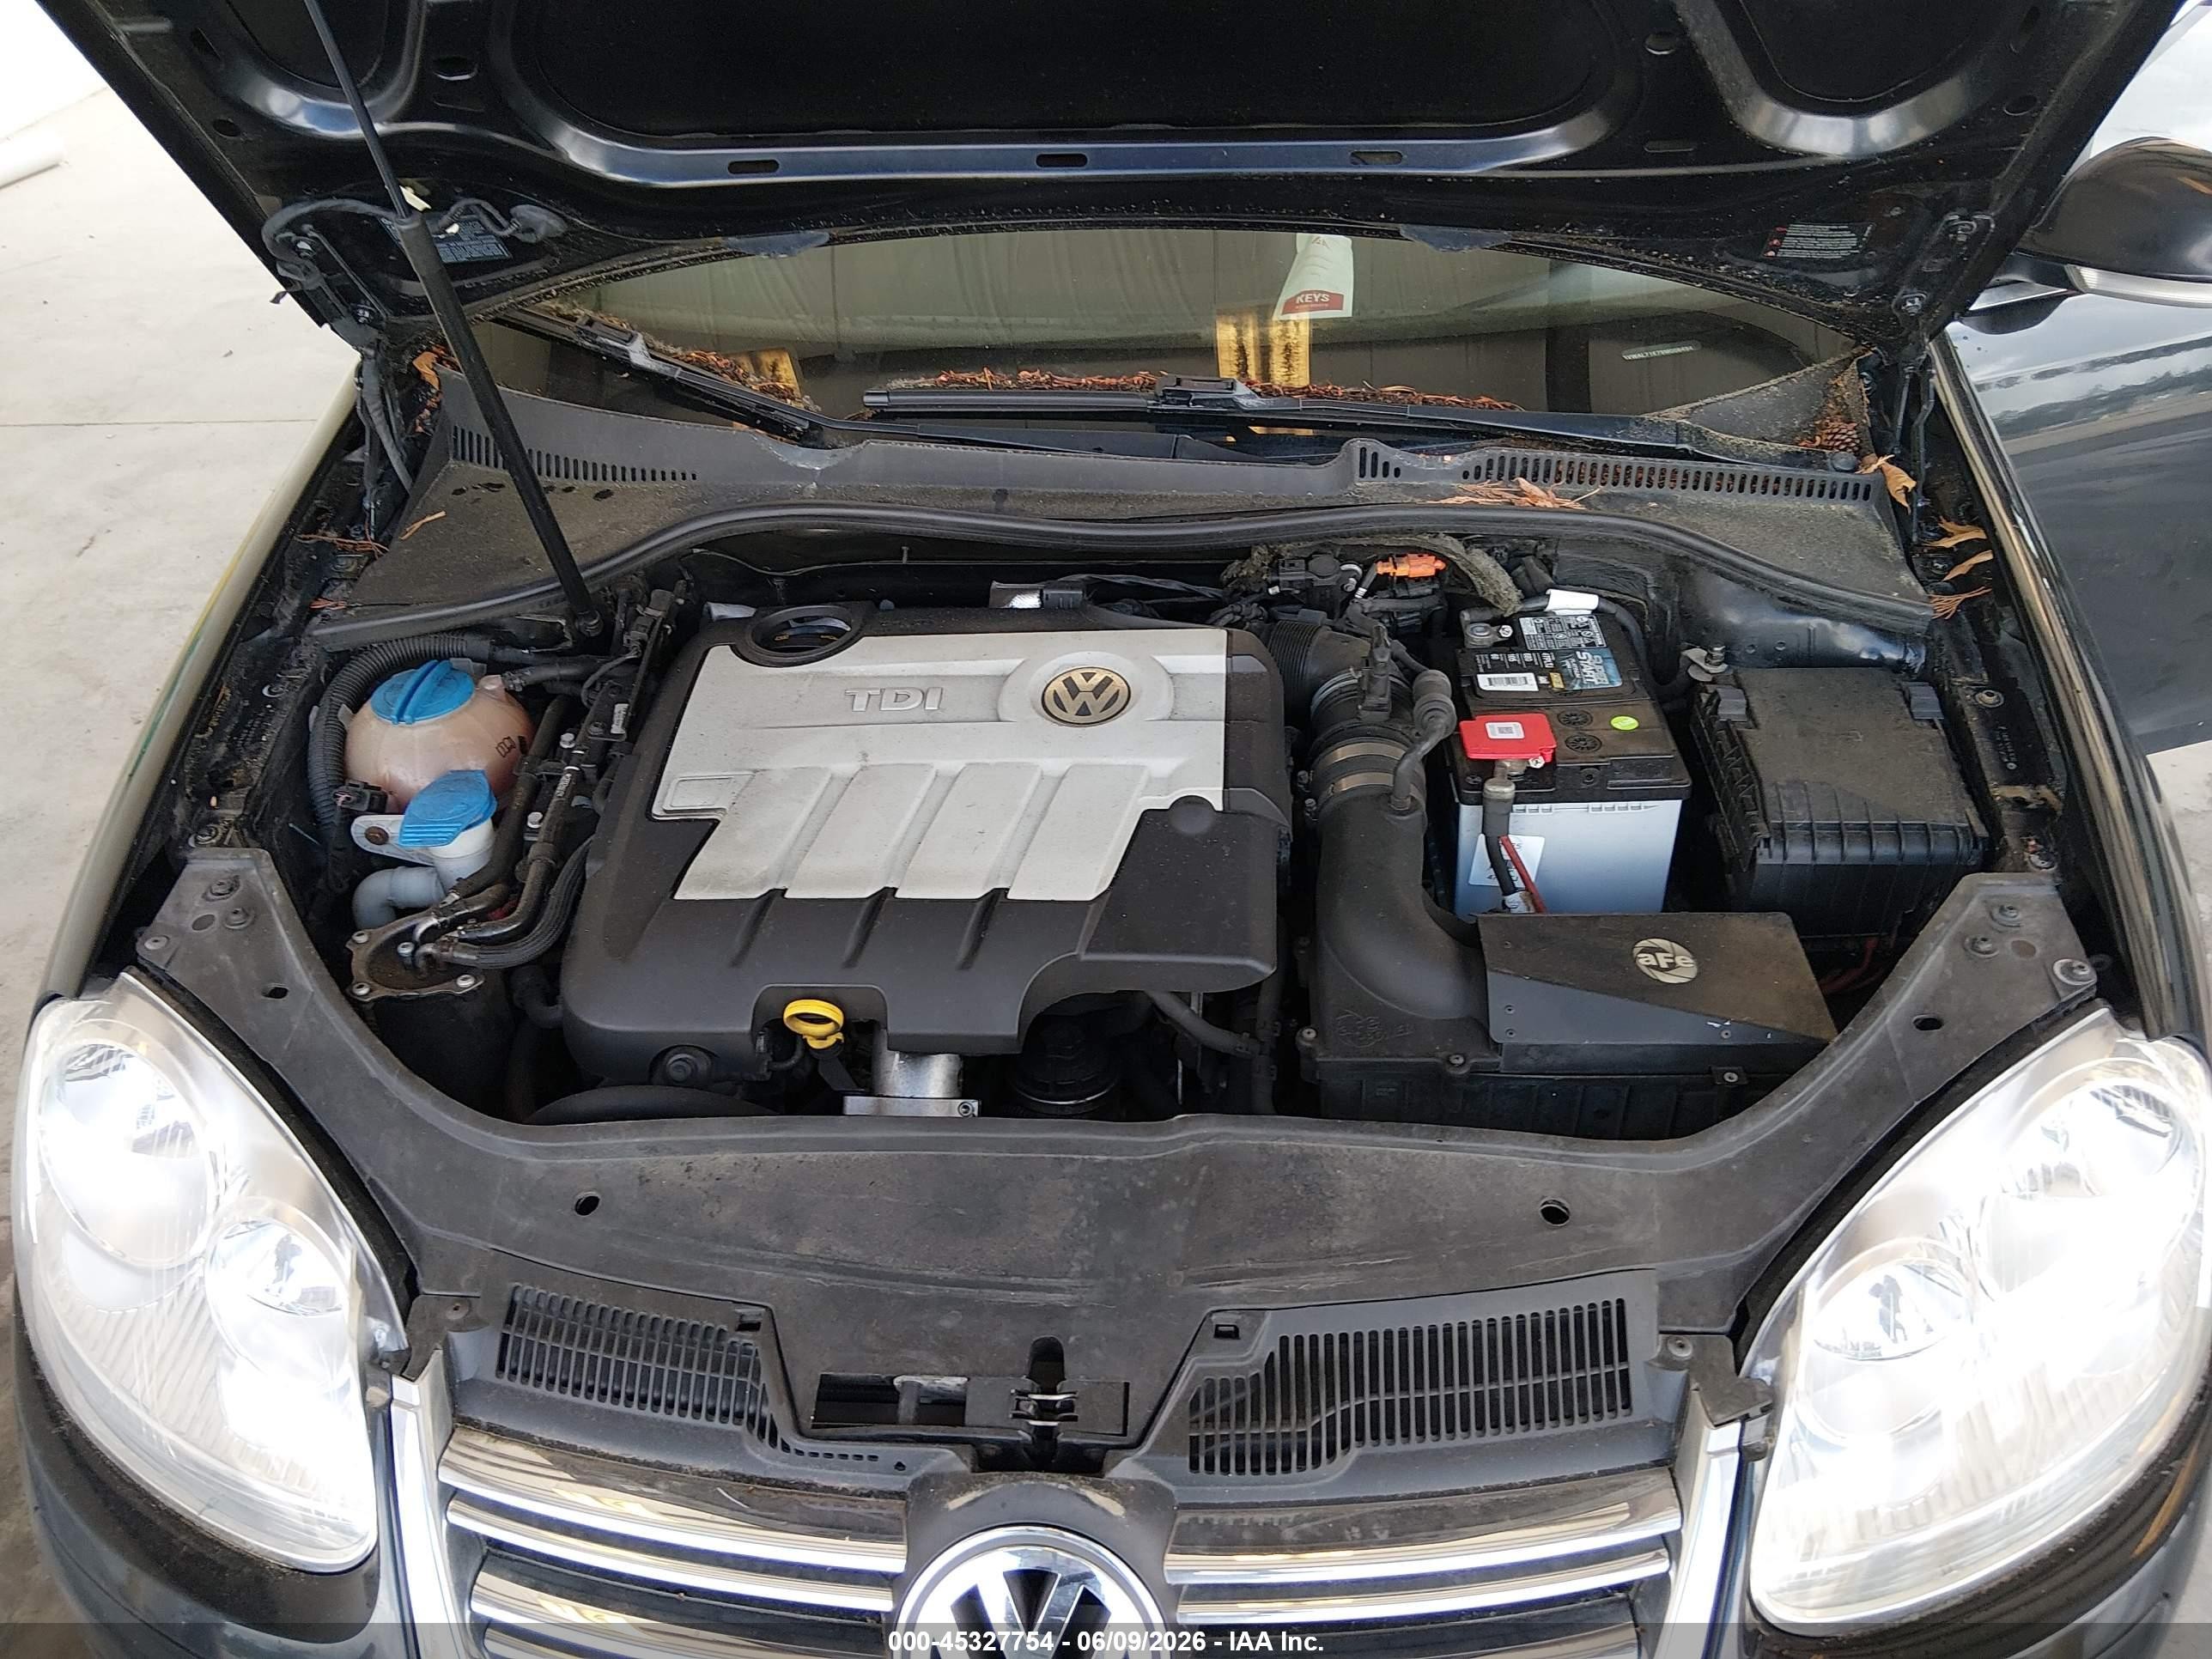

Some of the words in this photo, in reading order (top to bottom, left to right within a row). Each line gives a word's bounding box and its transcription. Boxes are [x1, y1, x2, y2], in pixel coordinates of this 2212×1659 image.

[1295, 293, 1330, 304] KEYS
[1576, 651, 1597, 684] START
[1593, 654, 1610, 685] SUPER
[845, 687, 944, 712] TDI
[1637, 951, 1695, 969] aFe
